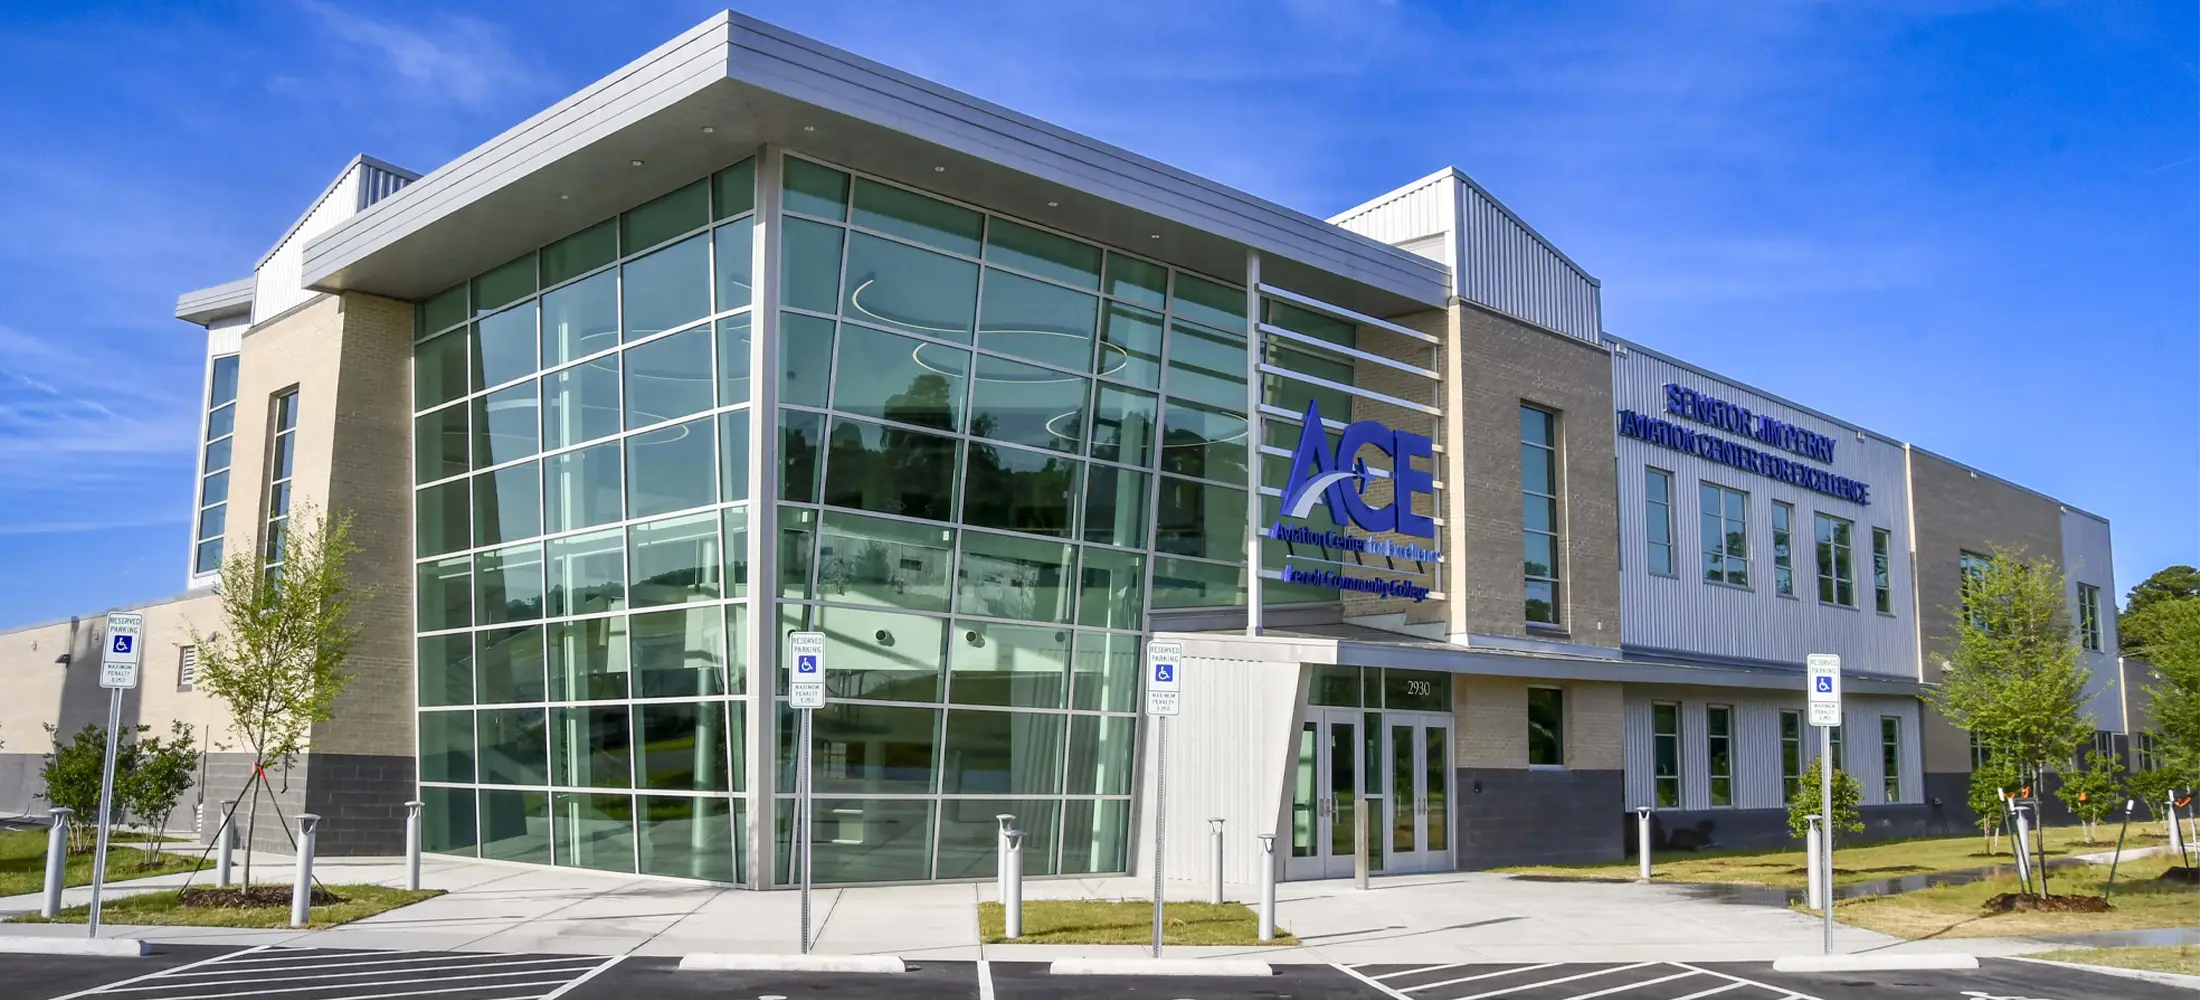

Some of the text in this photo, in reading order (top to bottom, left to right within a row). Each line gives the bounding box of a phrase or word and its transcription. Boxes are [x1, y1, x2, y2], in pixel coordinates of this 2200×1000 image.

[1666, 383, 1836, 465] SENATOR JIM PERRY
[1618, 409, 1870, 506] AVIATION CENTER FOR EXCELLENCE
[1280, 398, 1434, 538] ACE
[1270, 521, 1326, 547] Aviation
[1325, 570, 1389, 599] Community
[110, 616, 141, 625] RESERVED
[110, 626, 138, 634] PARKING
[793, 637, 823, 645] RESERVED
[1151, 646, 1180, 654] RESERVED
[1152, 655, 1179, 663] PARKING
[1812, 667, 1837, 675] PARKING
[1407, 680, 1431, 696] 2930
